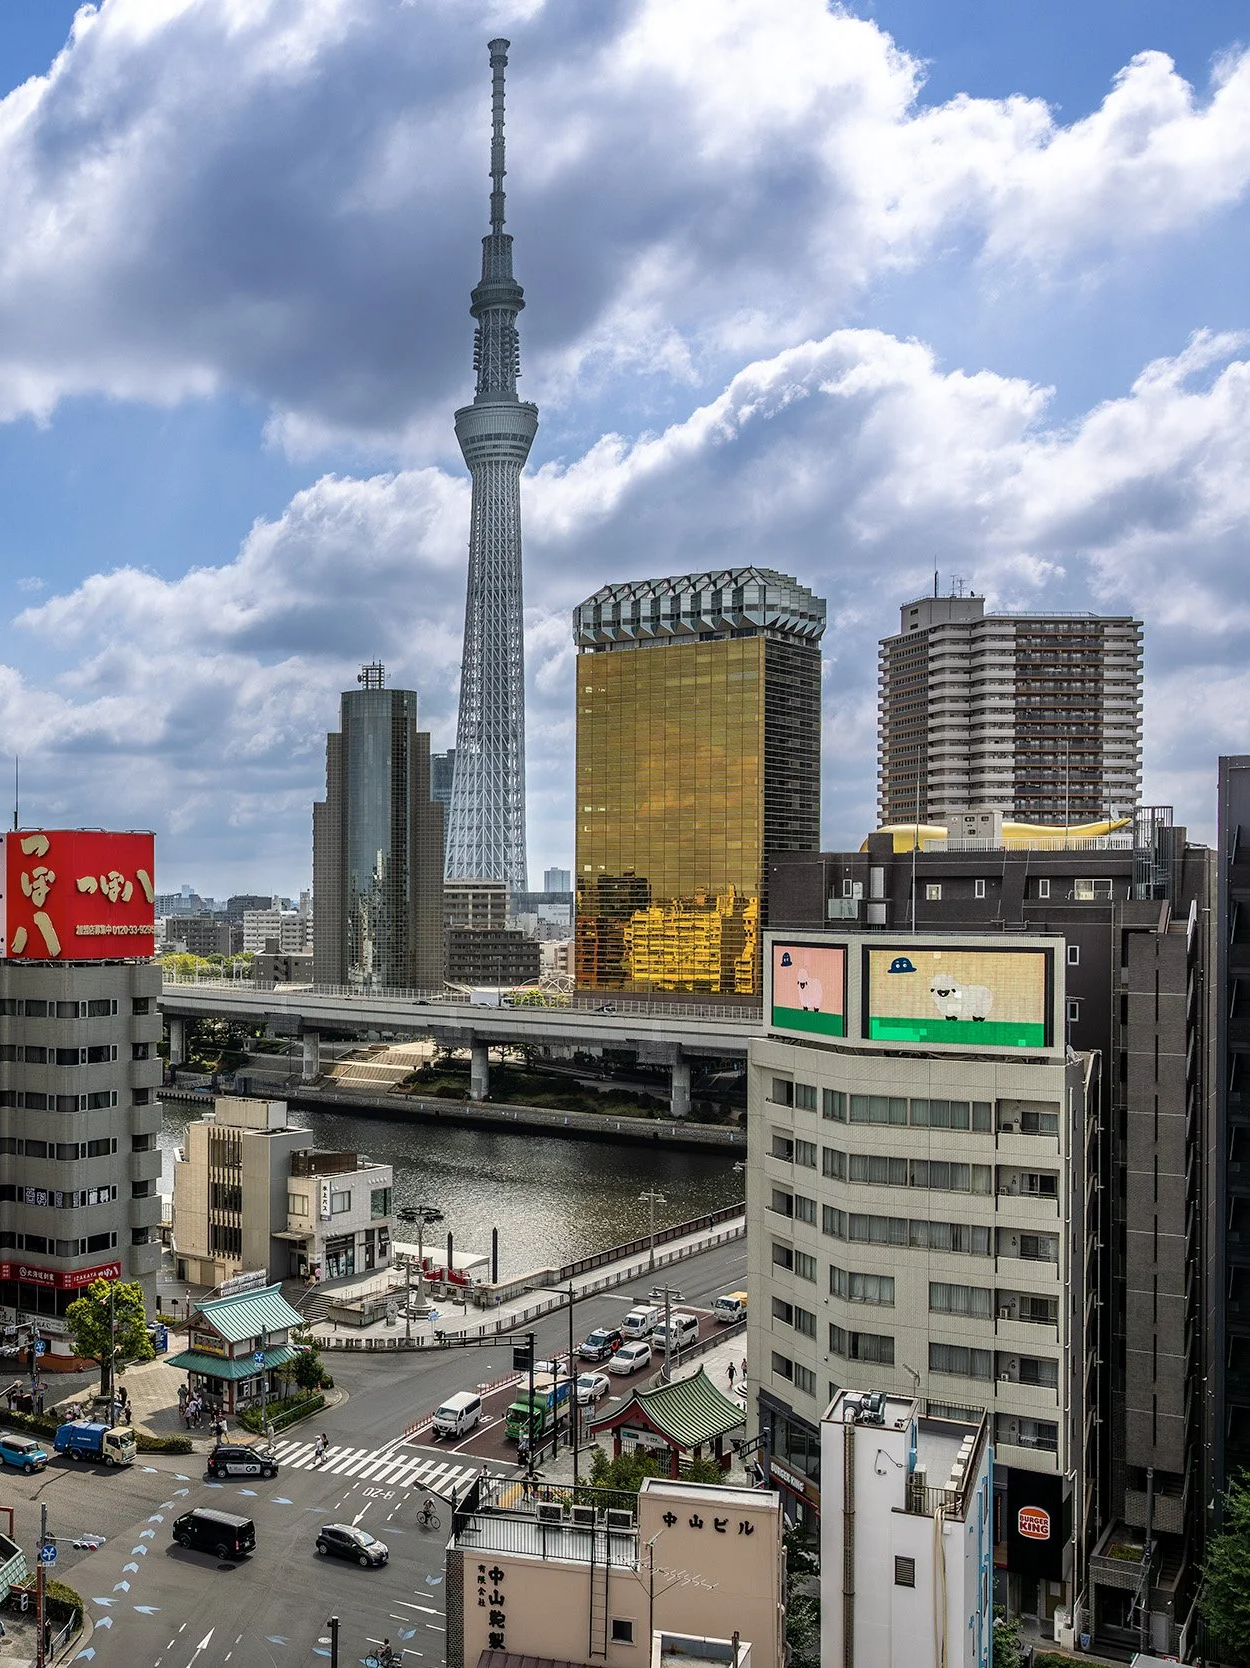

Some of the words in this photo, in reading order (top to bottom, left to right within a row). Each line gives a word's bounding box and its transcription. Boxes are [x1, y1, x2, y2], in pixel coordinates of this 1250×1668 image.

[11, 834, 61, 957] つぼ八
[76, 869, 154, 903] つぼ八
[74, 1272, 97, 1282] IZAKAYA
[362, 1486, 396, 1500] 8-20
[662, 1511, 754, 1536] 中山ビル
[1020, 1515, 1049, 1526] BURGER
[1020, 1522, 1049, 1534] KING
[477, 1564, 486, 1607] 有限会社
